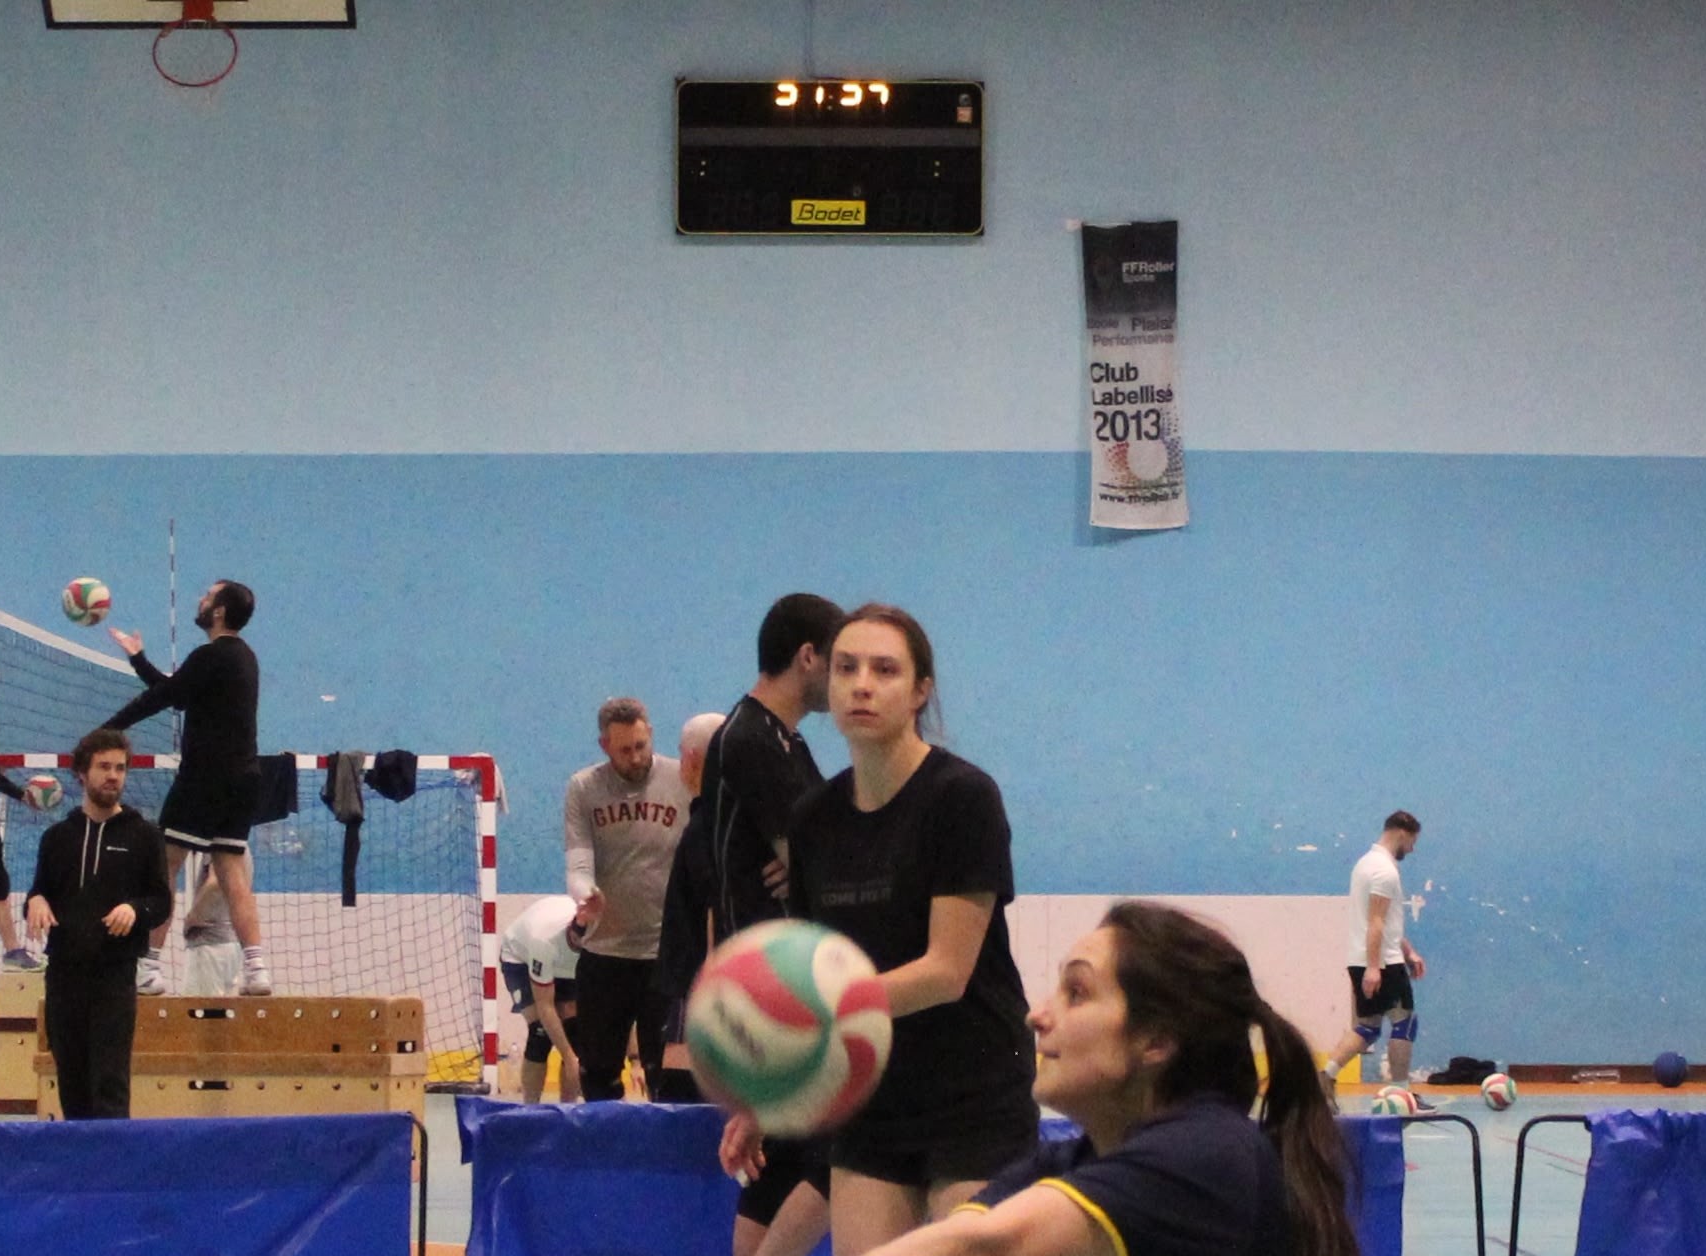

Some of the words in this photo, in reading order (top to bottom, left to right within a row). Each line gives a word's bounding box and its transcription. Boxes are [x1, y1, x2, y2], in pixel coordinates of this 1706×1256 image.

[796, 203, 862, 222] Bodet
[1122, 261, 1174, 273] FFRoller
[1090, 362, 1139, 383] Club
[1092, 383, 1173, 406] Labellisé
[1094, 409, 1161, 442] 2013
[593, 801, 677, 828] GIANTS
